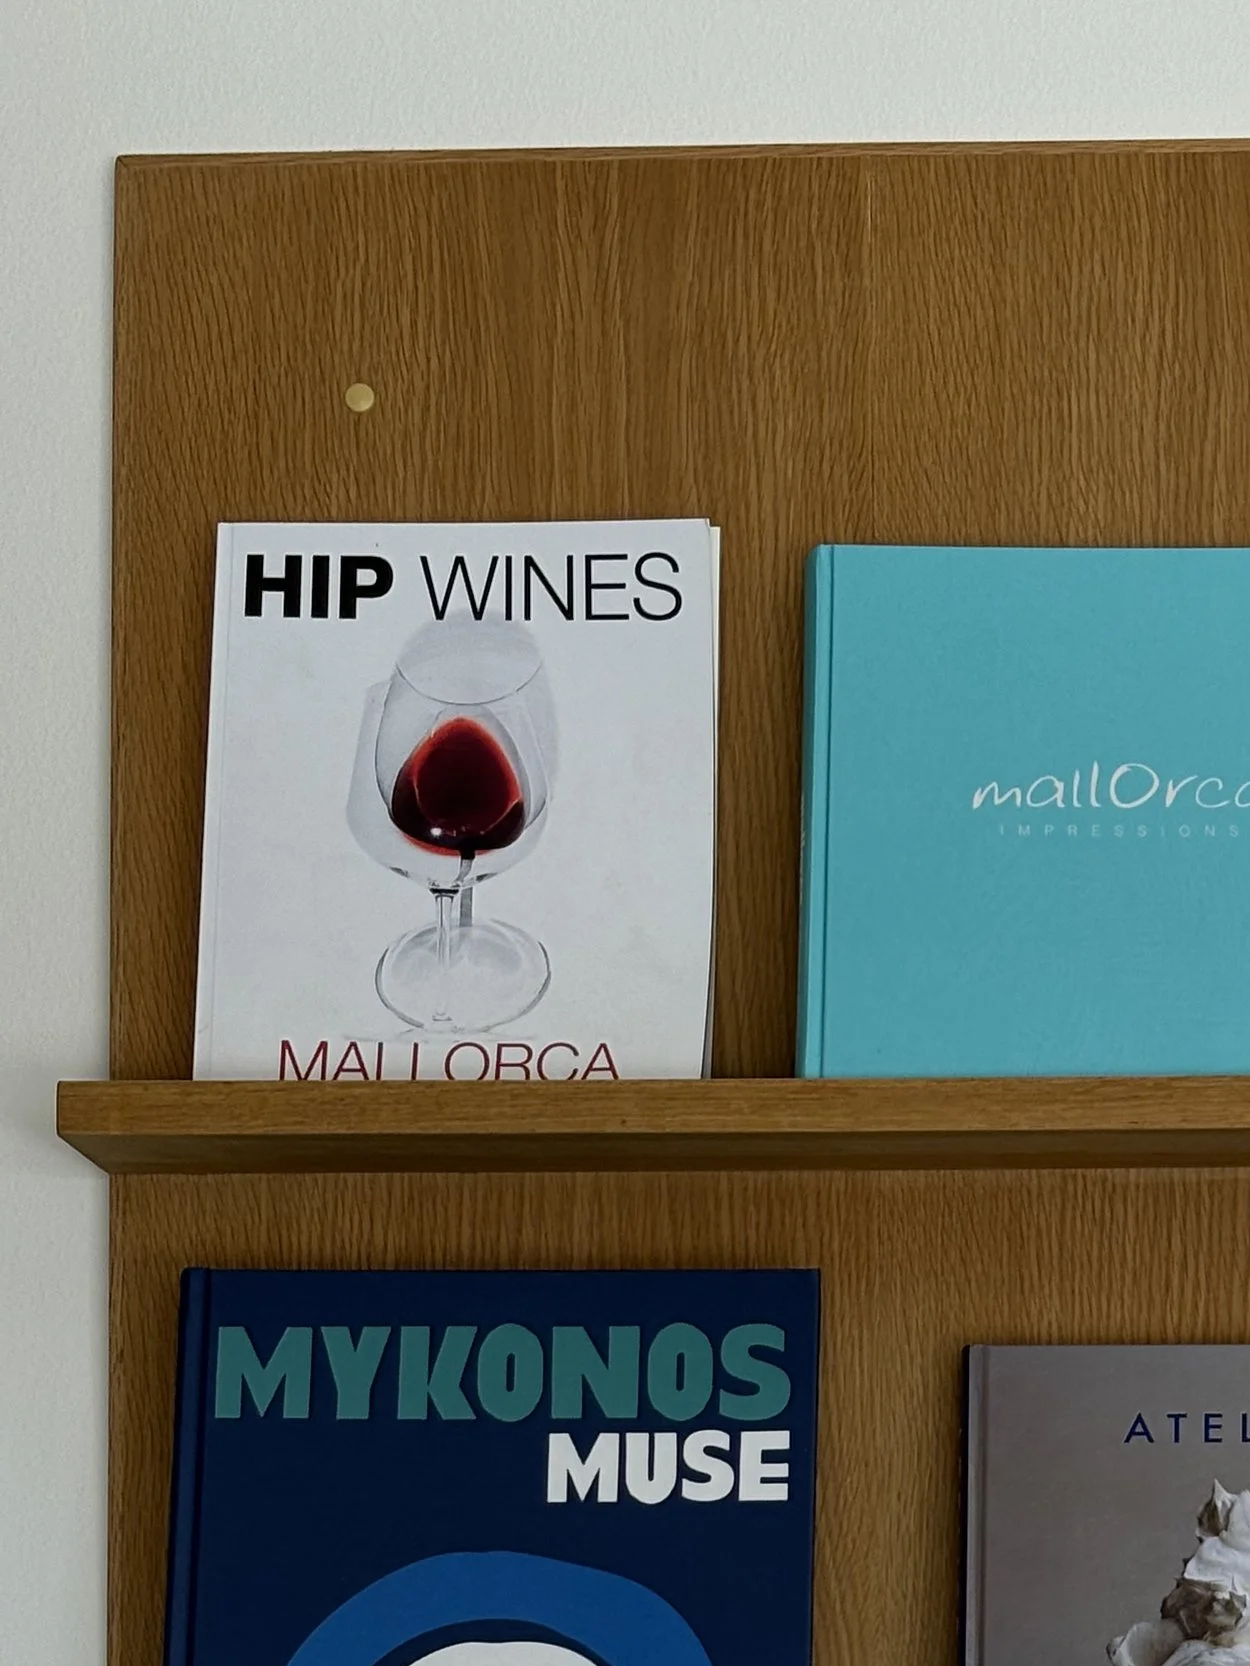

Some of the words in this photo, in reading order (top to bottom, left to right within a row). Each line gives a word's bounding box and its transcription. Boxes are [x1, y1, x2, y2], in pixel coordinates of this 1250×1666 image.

[244, 553, 394, 620] HIP
[420, 552, 684, 622] WINES
[998, 824, 1240, 838] IMPRESSIONS
[214, 1323, 792, 1422] MYKONOS
[546, 1430, 790, 1504] MUSE
